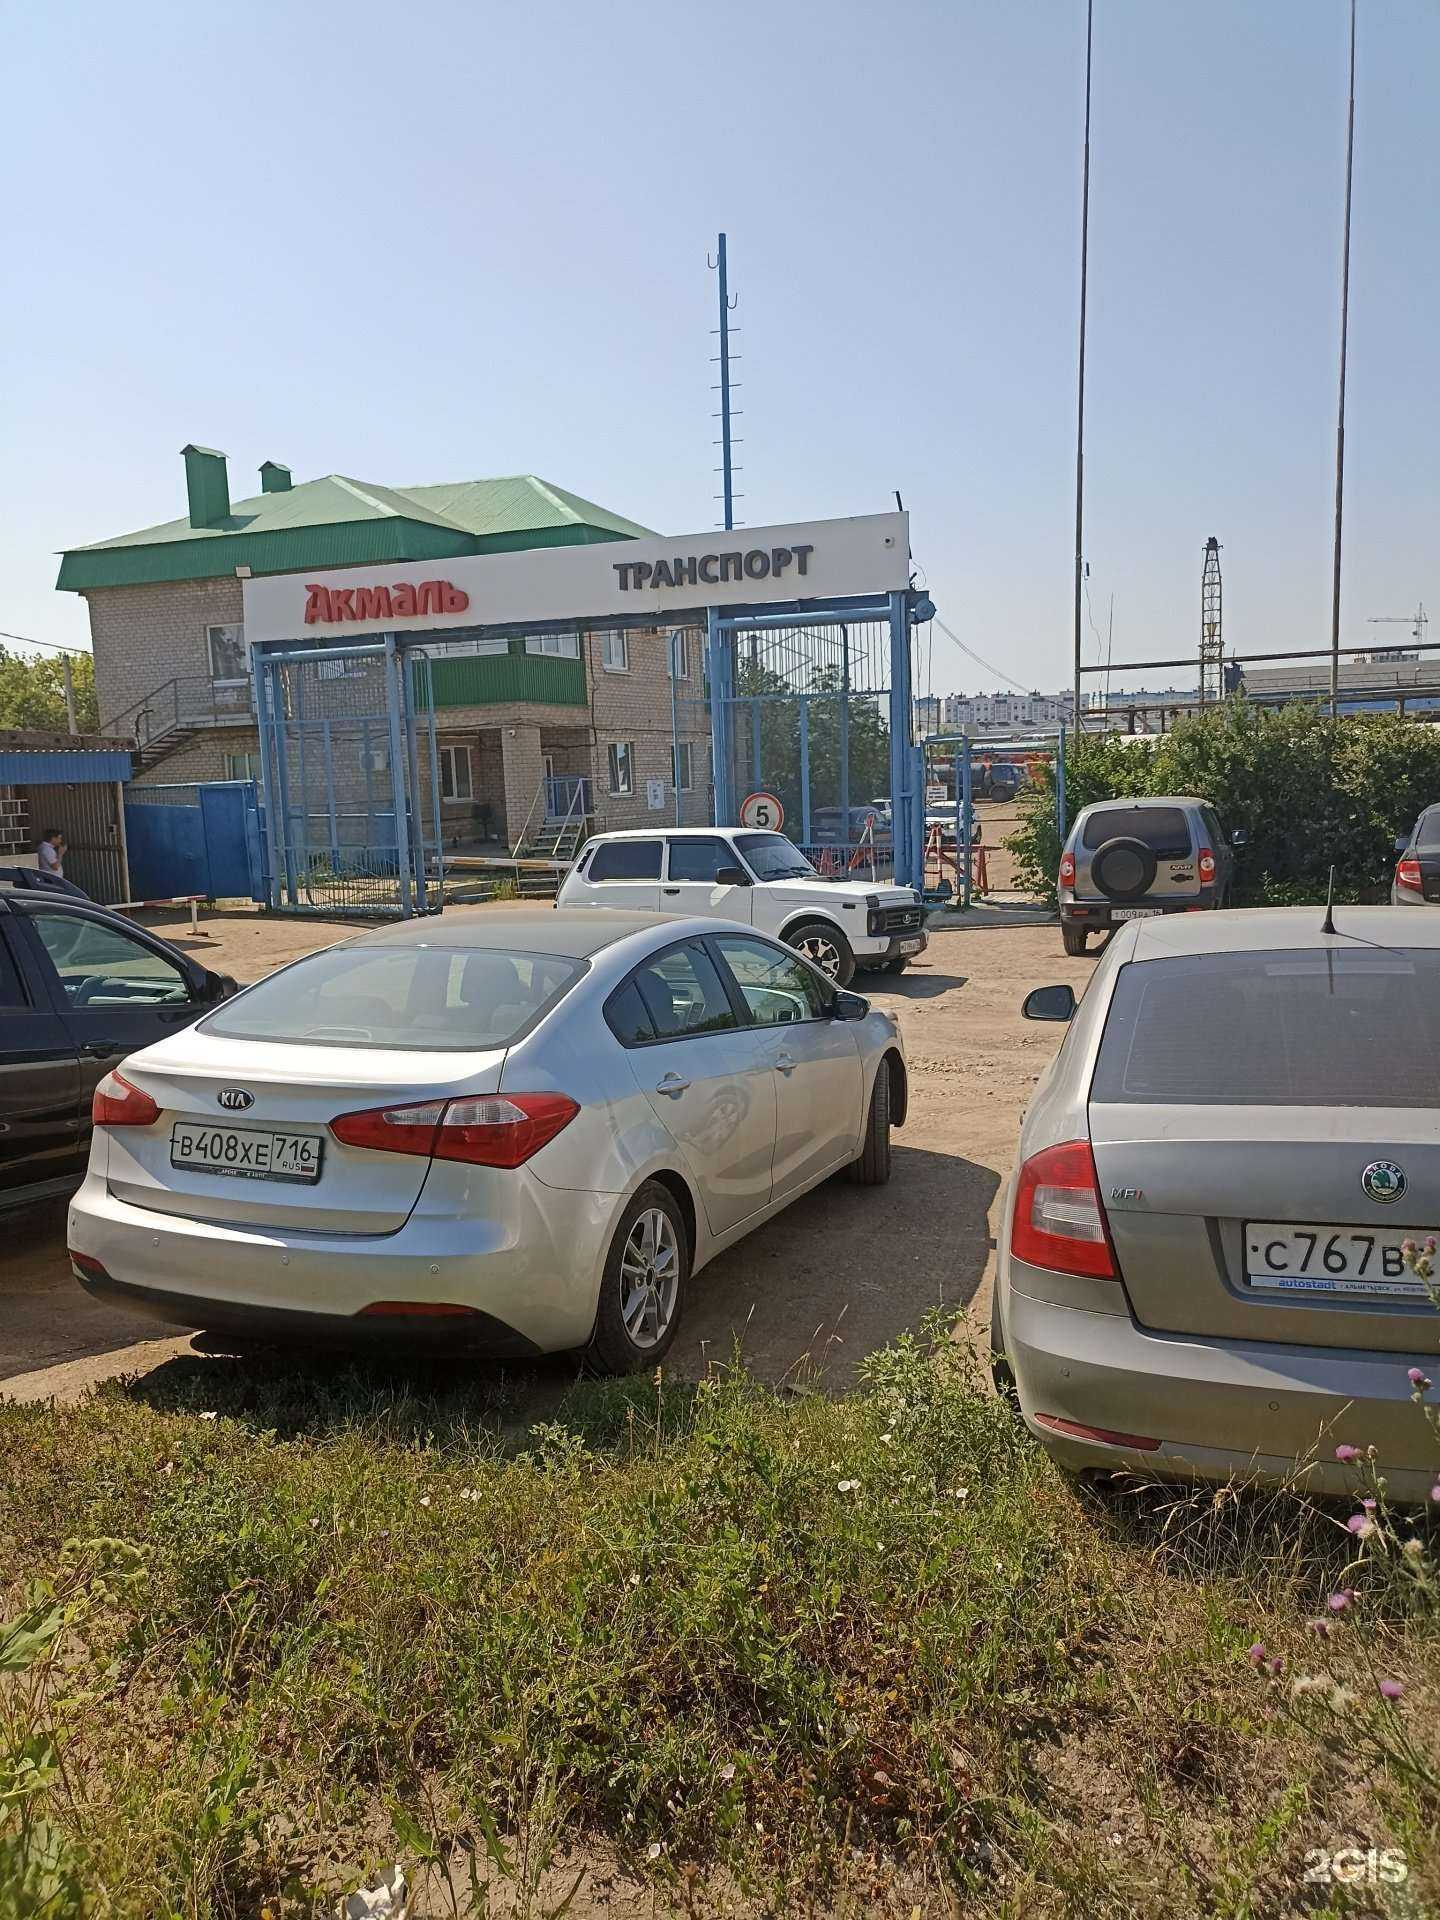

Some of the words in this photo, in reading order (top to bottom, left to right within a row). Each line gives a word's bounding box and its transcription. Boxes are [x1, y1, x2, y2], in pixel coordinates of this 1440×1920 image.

[304, 580, 469, 625] Акмаль
[612, 544, 814, 591] ТРАНСПОРТ
[756, 805, 770, 827] 5
[220, 1091, 247, 1107] KIA
[275, 1137, 311, 1162] 716
[282, 1160, 301, 1171] RUS
[1279, 1278, 1337, 1290] autostadt
